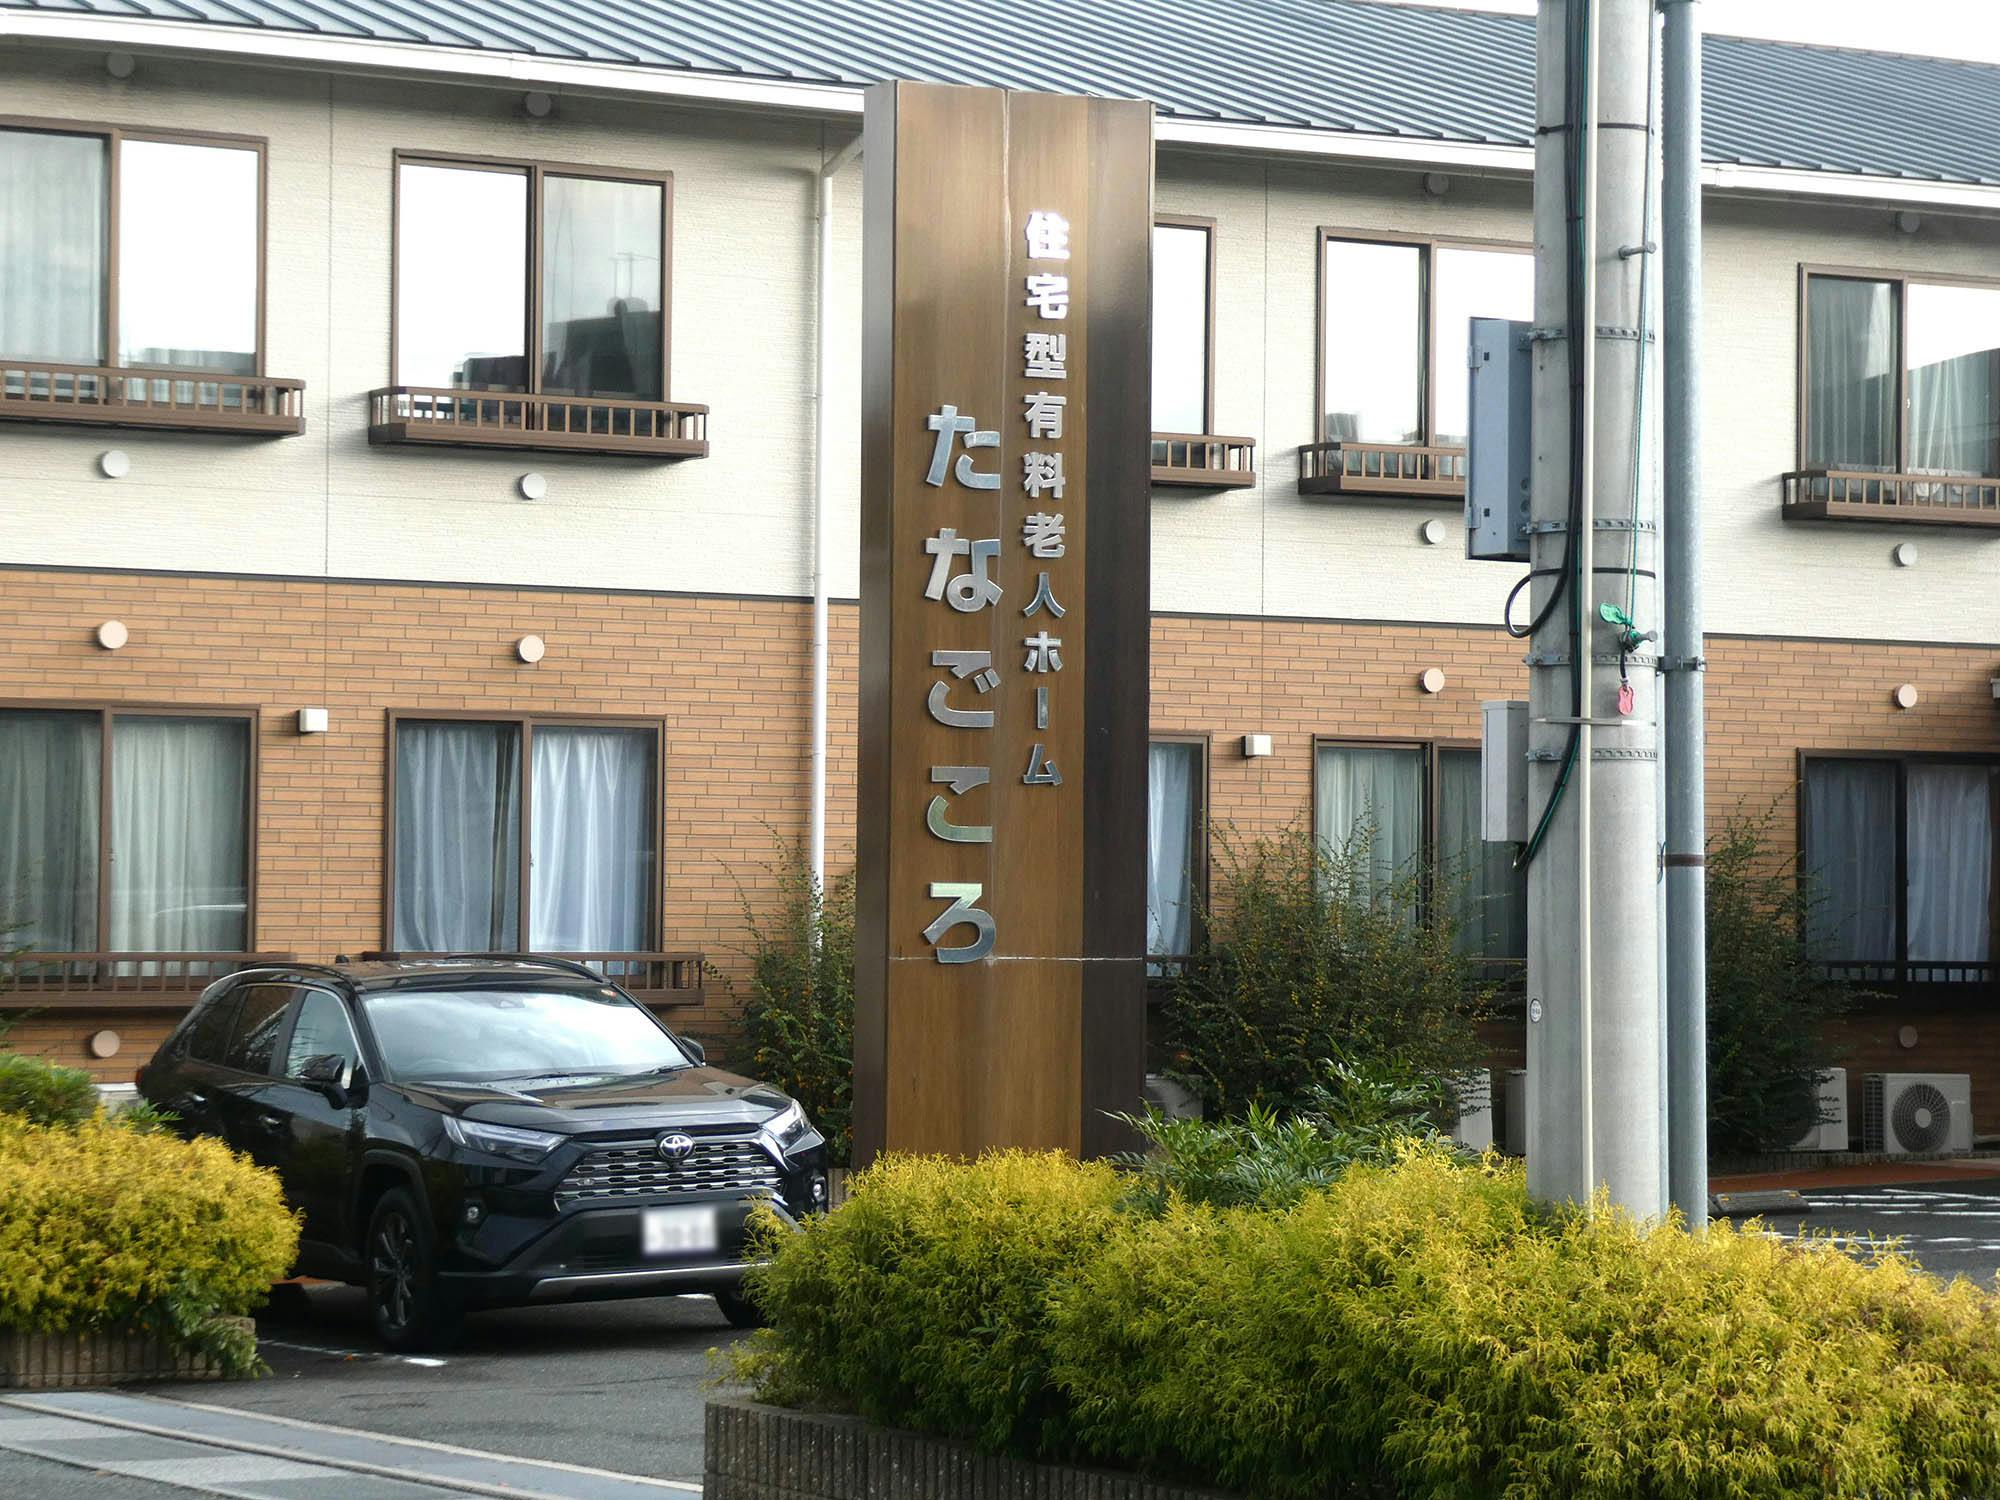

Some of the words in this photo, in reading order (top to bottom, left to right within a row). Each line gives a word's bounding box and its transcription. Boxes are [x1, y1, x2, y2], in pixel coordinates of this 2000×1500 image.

[922, 404, 1004, 964] たなごころ
[1022, 211, 1070, 786] 住宅型有料老人ホーム
